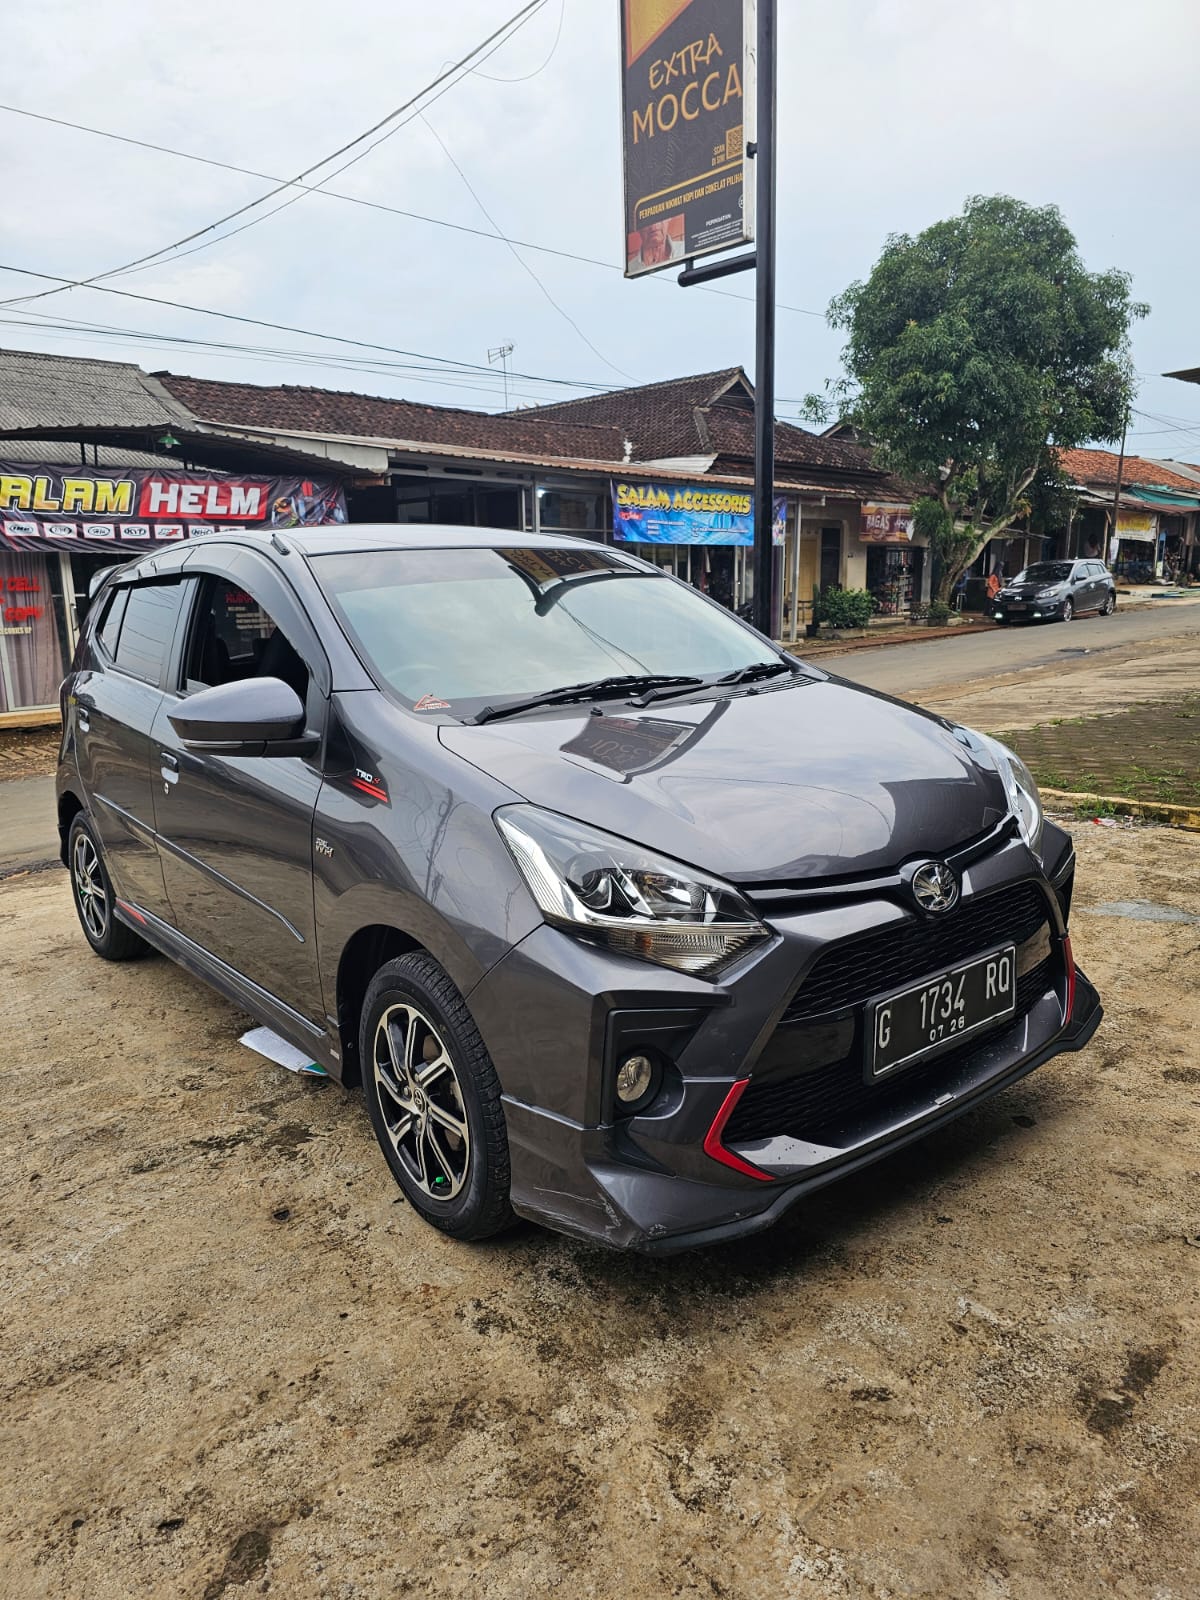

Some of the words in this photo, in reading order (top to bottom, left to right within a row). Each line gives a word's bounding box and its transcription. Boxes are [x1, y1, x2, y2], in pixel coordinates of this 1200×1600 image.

[649, 32, 723, 90] EXTRA
[632, 63, 743, 145] MOCCA
[149, 481, 261, 516] HELM
[616, 483, 671, 512] SALAM
[672, 488, 752, 516] ACCESSORIS
[7, 576, 41, 592] CELL
[5, 605, 44, 622] COPY
[355, 768, 373, 783] TRD
[878, 1009, 891, 1048] G
[920, 974, 966, 1029] 1734
[986, 957, 1010, 1000] RQ
[929, 1025, 944, 1042] 07
[950, 1015, 965, 1032] 28
